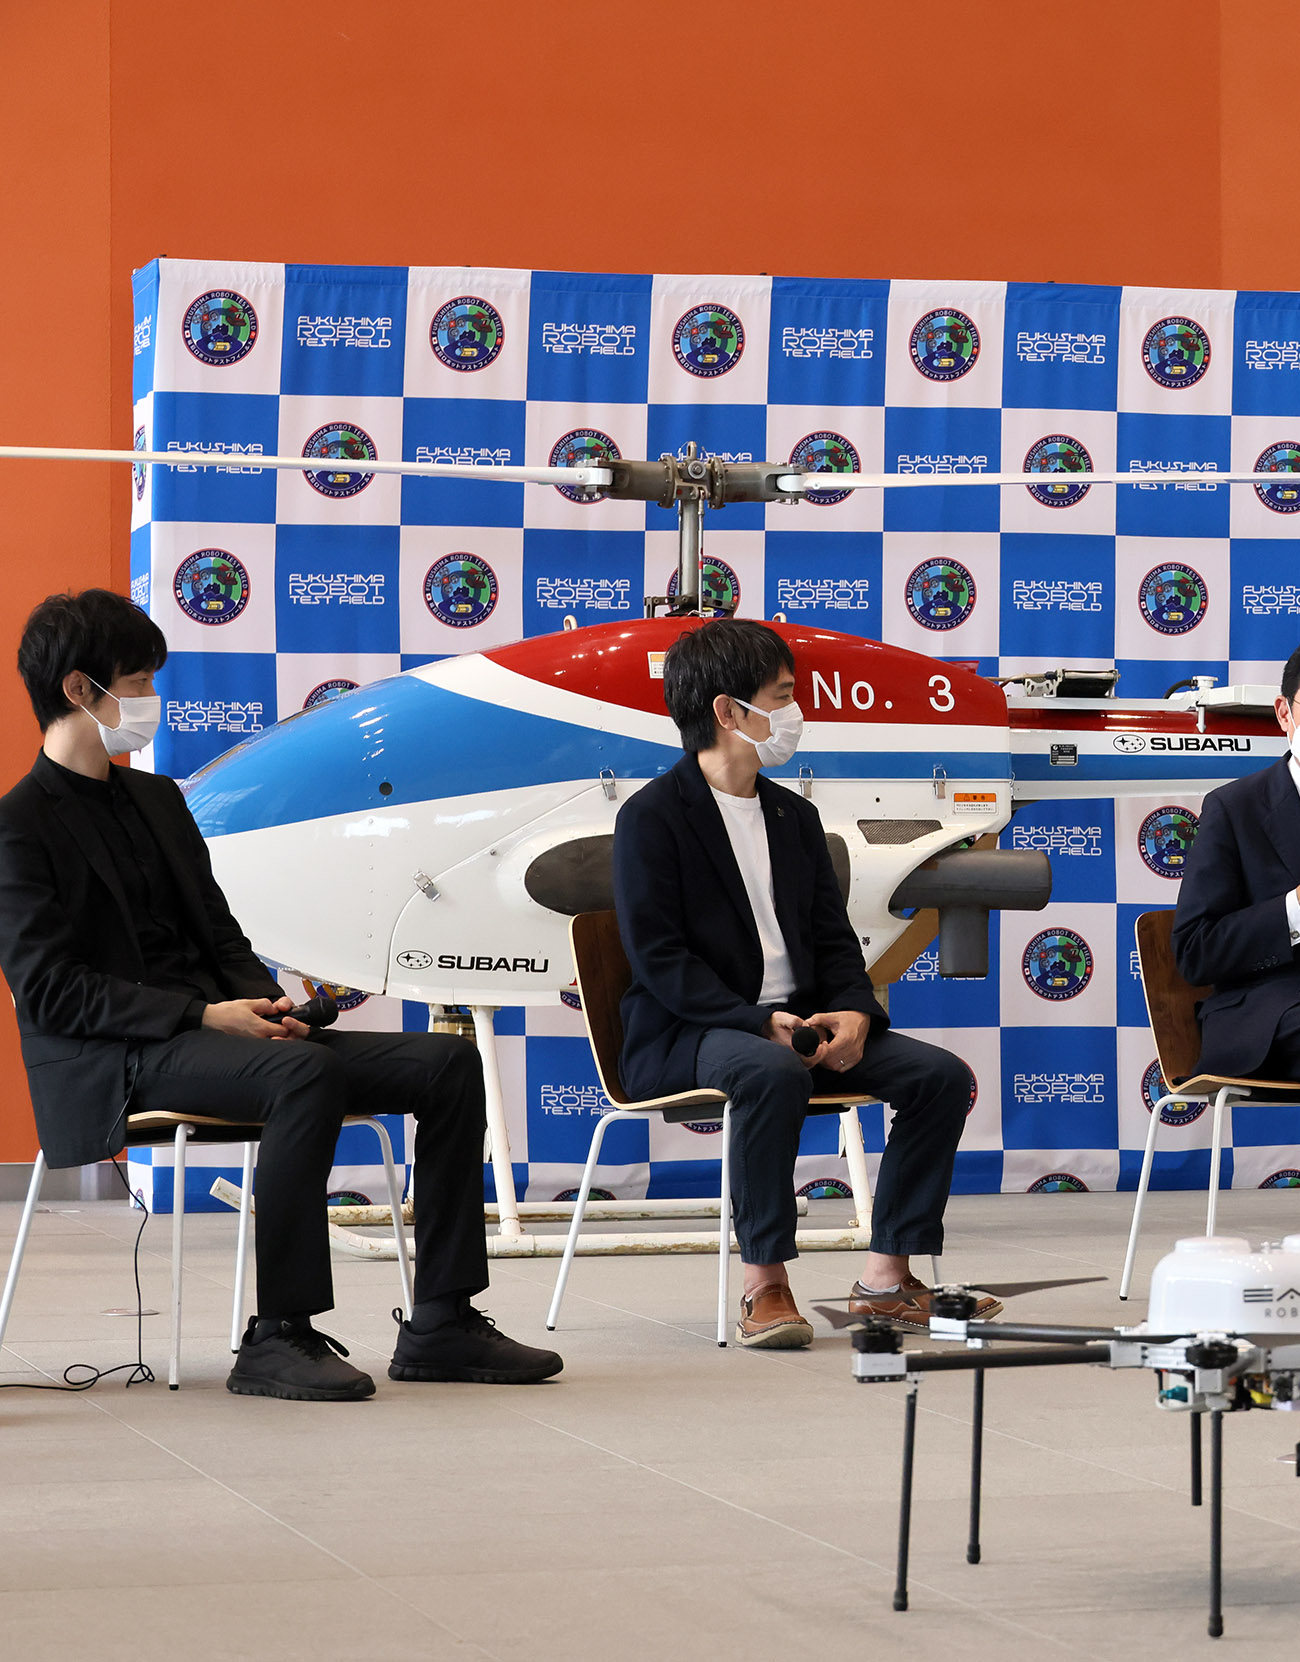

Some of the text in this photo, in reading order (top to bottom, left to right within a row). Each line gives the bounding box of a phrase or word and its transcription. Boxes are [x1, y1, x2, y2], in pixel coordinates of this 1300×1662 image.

[184, 296, 210, 328] FUKUSHIMA
[235, 296, 249, 310] TEST
[247, 310, 256, 330] FIELD
[298, 316, 392, 326] FUKUSHIMA
[432, 302, 456, 334] FUKUSHIMA
[481, 303, 496, 316] TEST
[494, 317, 502, 337] FIELD
[297, 325, 391, 338] ROBOT
[543, 323, 636, 334] FUKUSHIMA
[674, 310, 698, 341] FUKUSHIMA
[722, 310, 736, 323] TEST
[734, 323, 742, 343] FIELD
[783, 327, 874, 338] FUKUSHIMA
[911, 314, 935, 345] FUKUSHIMA
[958, 315, 972, 328] TEST
[970, 328, 978, 347] FIELD
[298, 338, 391, 348] TEST FIELD
[543, 332, 635, 346] ROBOT
[783, 336, 873, 350] ROBOT
[1017, 332, 1106, 343] FUKUSHIMA
[1143, 322, 1166, 353] FUKUSHIMA
[1189, 323, 1202, 336] TEST
[543, 344, 635, 356] TEST FIELD
[783, 348, 873, 359] TEST FIELD
[1017, 341, 1105, 355] ROBOT
[1017, 353, 1105, 364] TEST FIELD
[1246, 361, 1285, 370] TEST
[168, 441, 263, 453] FUKUSHIMA
[303, 428, 328, 458] UKUSHIMA
[353, 429, 368, 442] TEST
[600, 435, 614, 448] TEST
[416, 447, 511, 458] FUKUSHIMA
[838, 438, 852, 450] TEST
[850, 451, 859, 470] FIELD
[1025, 440, 1048, 472] FUKUSHIMA
[1072, 441, 1085, 454] TEST
[898, 455, 987, 464] FUKUSHIMA
[1130, 460, 1217, 470] FUKUSHIMA
[216, 466, 263, 474] FIELD
[898, 464, 987, 474] ROBOT
[176, 555, 201, 587] FUKUSHIMA
[226, 555, 241, 569] TEST
[239, 569, 248, 589] FIELD
[426, 558, 450, 590] FUKUSHIMA
[475, 559, 490, 572] TEST
[488, 573, 496, 593] FIELD
[289, 574, 384, 583] FUKUSHIMA
[537, 578, 630, 588] FUKUSHIMA
[717, 562, 738, 595] TEST FIELD
[778, 579, 869, 588] FUKUSHIMA
[906, 563, 930, 594] FUKUSHIMA
[954, 564, 968, 577] TEST
[966, 577, 974, 597] FIELD
[1140, 568, 1163, 599] FUKUSHIMA
[1186, 569, 1200, 582] TEST
[1198, 582, 1206, 601] FIELD
[289, 583, 384, 595] ROBOT
[1014, 580, 1102, 590] FUKUSHIMA
[537, 587, 630, 600] ROBOT
[778, 588, 868, 600] ROBOT
[1013, 589, 1102, 602] ROBOT
[290, 595, 384, 605] TEST FIELD
[537, 599, 630, 609] TEST FIELD
[778, 600, 868, 609] TEST FIELD
[1014, 601, 1102, 611] TEST FIELD
[1243, 606, 1282, 614] TEST
[812, 671, 955, 712] No. 3
[167, 701, 263, 711] FUKUSHIMA
[167, 710, 263, 723] ROBOT
[168, 723, 263, 733] TEST FIELD
[1150, 737, 1251, 752] SUBARU
[1013, 826, 1101, 835] FUKUSHIMA
[1139, 811, 1162, 842] FUKUSHIMA
[1013, 835, 1101, 847] ROBOT
[1060, 847, 1102, 856] FIELD
[1023, 933, 1047, 964] FUKUSHIMA
[1071, 934, 1085, 947] TEST
[1083, 947, 1091, 967] FIELD
[438, 955, 548, 972] SUBARU
[900, 972, 940, 981] TEST
[1015, 1074, 1104, 1082] FUKUSHIMA
[541, 1084, 606, 1095] FUKUSH
[1014, 1082, 1104, 1094] ROBOT
[541, 1094, 609, 1108] ROBO
[1015, 1095, 1104, 1103] TEST FIELD
[541, 1106, 584, 1115] TEST
[838, 1183, 850, 1195] TEST
[1071, 1178, 1083, 1190] TEST
